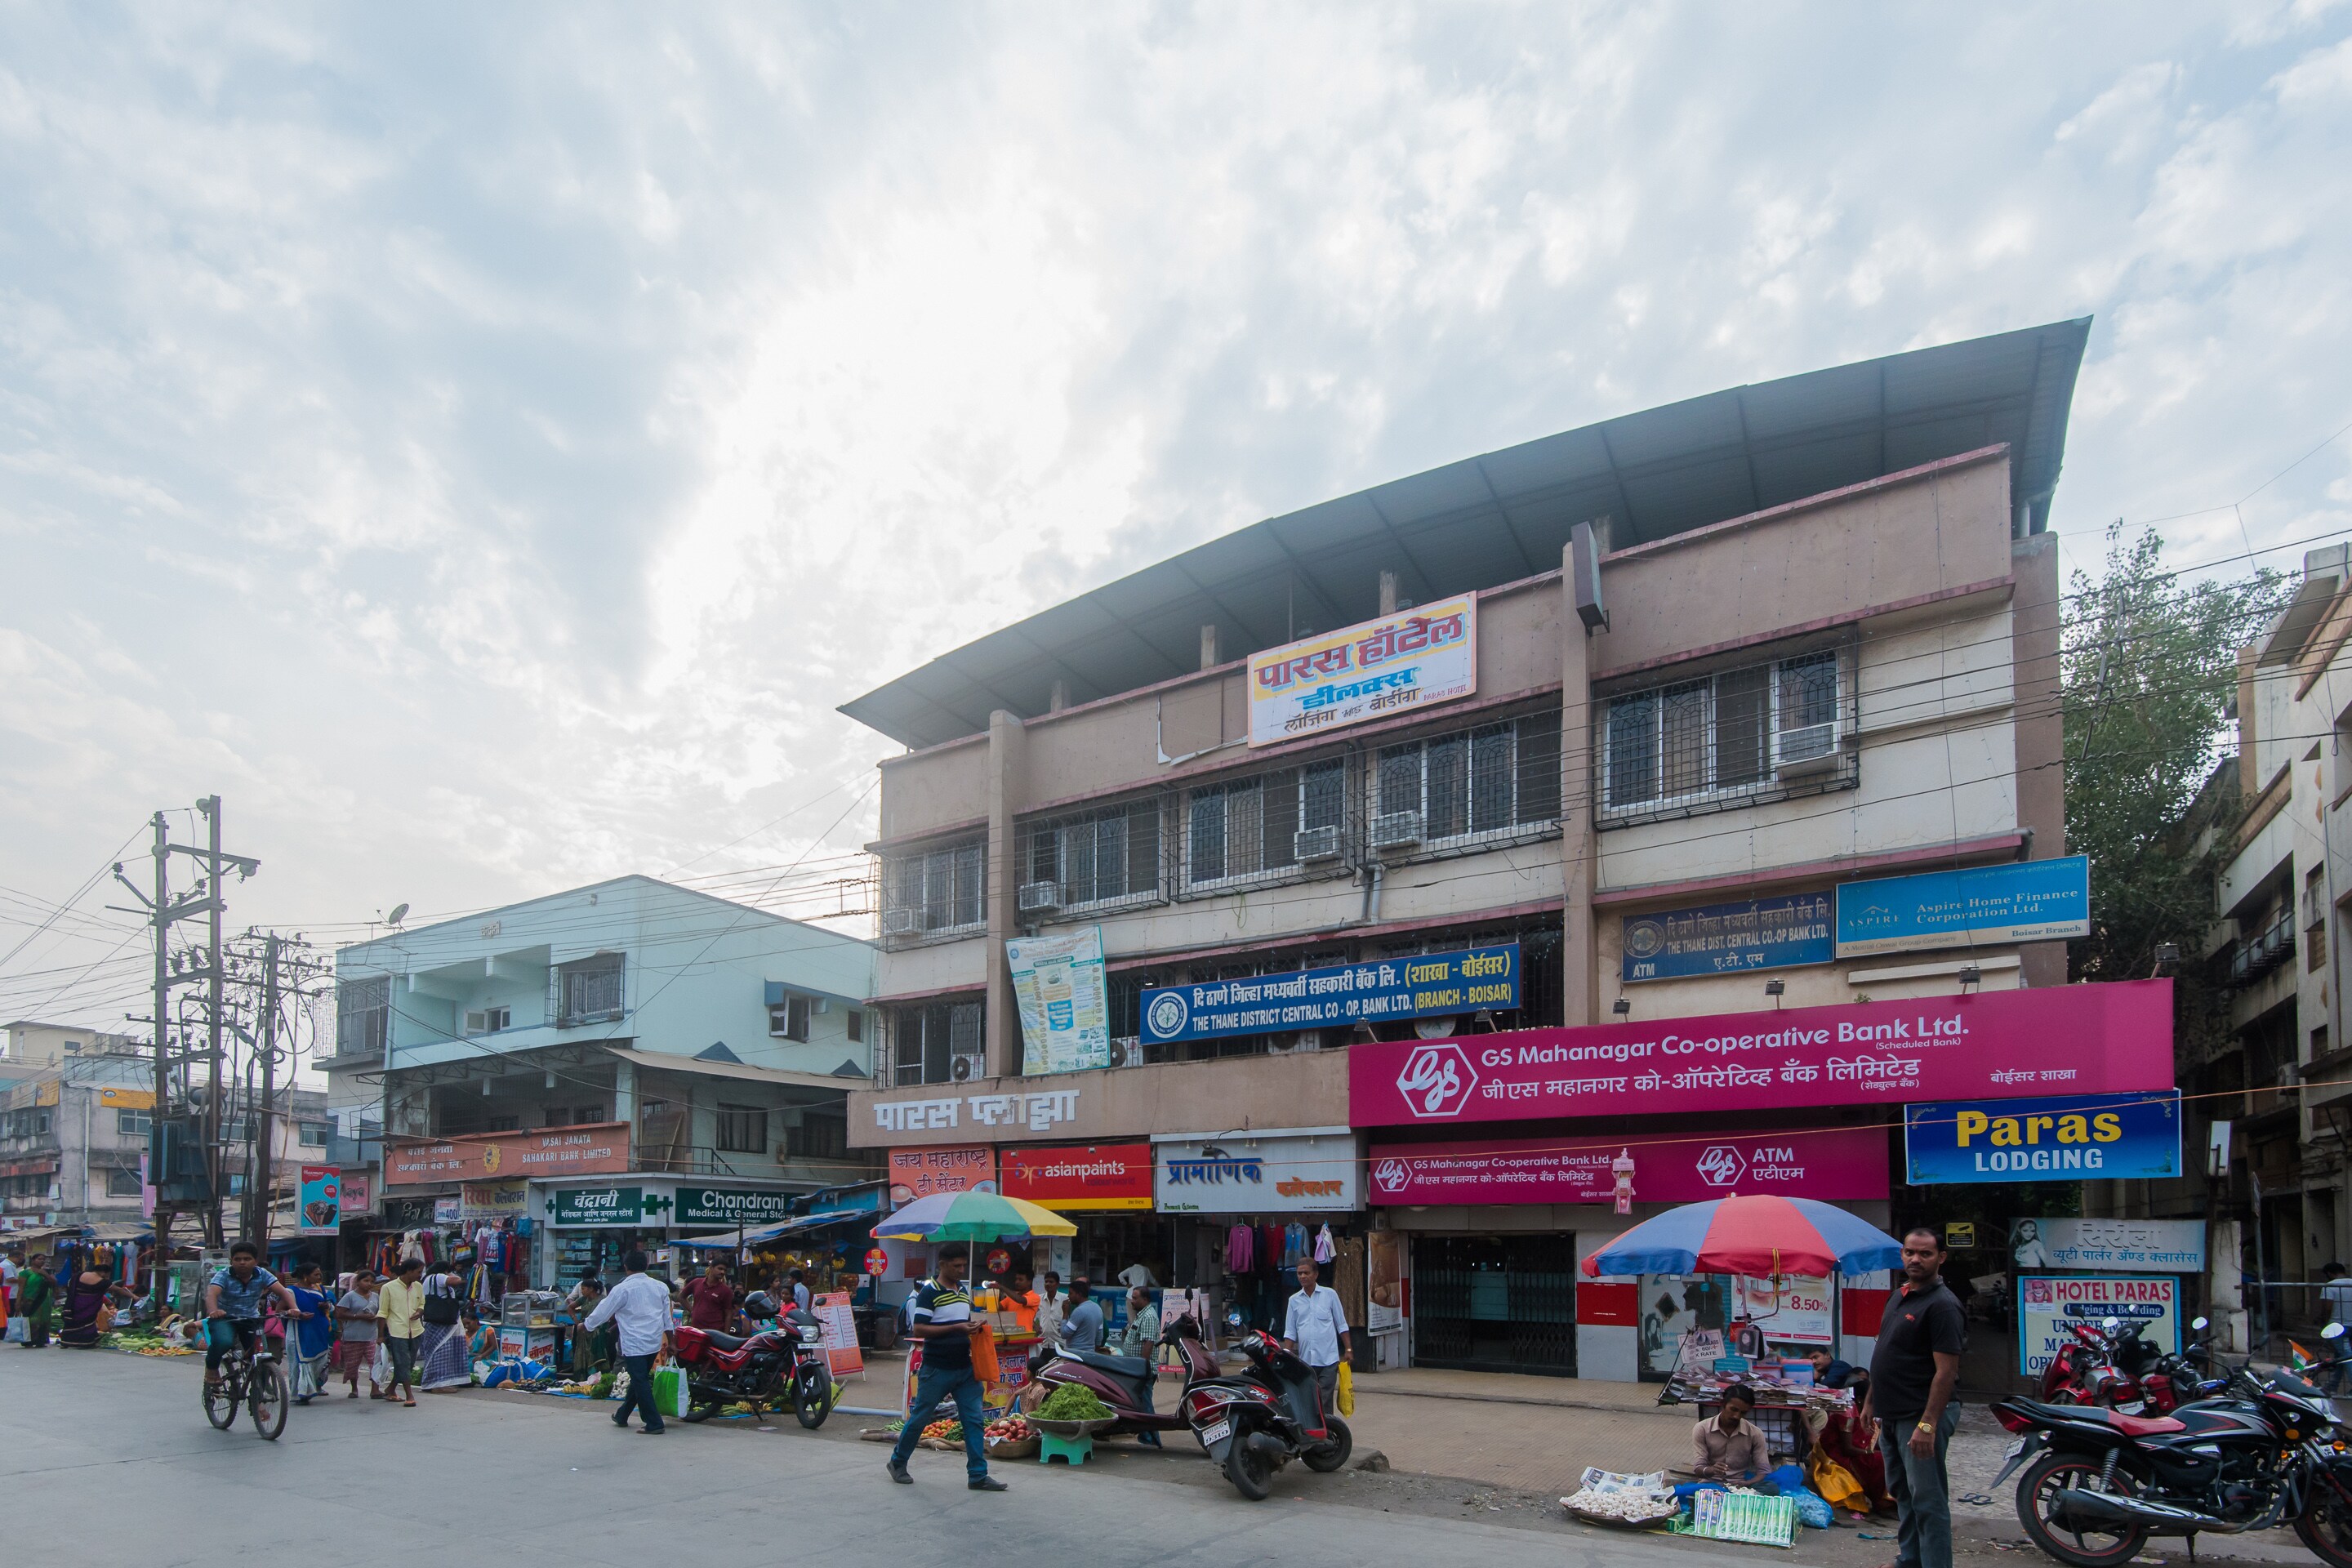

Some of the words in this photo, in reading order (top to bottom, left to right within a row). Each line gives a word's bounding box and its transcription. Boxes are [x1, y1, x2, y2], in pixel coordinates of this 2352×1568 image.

[1254, 644, 1349, 687] पारस
[1356, 612, 1463, 666] हॉटेल
[1295, 666, 1419, 710] डीलक्स
[1447, 684, 1467, 697] HOTEL
[1917, 900, 1964, 915] Aspire
[1969, 894, 2011, 907] Home
[2016, 889, 2078, 902] Finance
[1678, 912, 1695, 934] ठाणे
[1697, 911, 1721, 933] जिल्हा
[1723, 903, 1759, 929] मध्यवर्ती
[1760, 901, 1794, 925] सहकारी
[1797, 897, 1813, 920] बँक
[1847, 914, 1900, 928] ASPIRE
[1917, 906, 2008, 925] Corporation
[2013, 902, 2043, 915] Ltd.
[1667, 941, 1681, 955] THE
[1682, 938, 1706, 953] THANE
[1708, 936, 1726, 951] DIST.
[1727, 932, 1761, 948] CENTRAL
[1788, 925, 1811, 941] BANK
[1811, 924, 1829, 938] LTD.
[2011, 929, 2043, 938] Boisar
[2046, 924, 2081, 933] Branch
[1876, 941, 1897, 949] Oswal
[1899, 939, 1922, 947] Group
[1923, 936, 1956, 944] Company
[1633, 962, 1655, 978] ATM
[1193, 987, 1205, 1008] दि
[1206, 984, 1228, 1006] ठाणे
[1230, 982, 1261, 1004] जिल्हा
[1263, 974, 1308, 1000] मध्यवर्ती
[1308, 969, 1355, 995] सहकारी
[1356, 967, 1376, 990] बँक
[1379, 964, 1401, 987] लि.
[1192, 1015, 1209, 1031] THE
[1211, 1013, 1239, 1030] THANE
[1241, 1008, 1280, 1027] DISTRICT
[1282, 1004, 1323, 1023] CENTRAL
[1325, 1002, 1339, 1018] CO
[1346, 999, 1360, 1017] OP.
[1362, 996, 1389, 1014] BANK
[1391, 994, 1412, 1013] LTD.
[1414, 988, 1460, 1013] (BRANCH
[1468, 982, 1511, 1004] BOISAR)
[1481, 1048, 1512, 1067] GS
[1518, 1040, 1655, 1067] Mahanagar
[1661, 1024, 1829, 1059] Co-operative
[1838, 1017, 1910, 1043] Bank
[1918, 1013, 1969, 1037] Ltd.
[1875, 1040, 1930, 1052] (Scheduled
[1933, 1036, 1962, 1048] Bank)
[1545, 1076, 1628, 1098] महानगर
[1780, 1057, 1820, 1085] बँक
[1827, 1054, 1921, 1080] लिमिटेड
[1990, 1069, 2036, 1084] बोईसर
[2039, 1067, 2077, 1080] शाखा
[873, 1097, 962, 1132] पारस
[968, 1089, 1080, 1131] प्लाझा
[1956, 1110, 2122, 1147] Paras
[430, 1145, 453, 1154] जनता
[541, 1137, 561, 1147] VASAI
[564, 1134, 591, 1145] JANATA
[522, 1152, 557, 1163] SAHAKARI
[560, 1150, 579, 1160] BANK
[583, 1147, 611, 1160] LIMITED
[893, 1151, 922, 1169] जय
[927, 1148, 989, 1171] महाराष्ट्र
[1414, 1160, 1428, 1169] GS
[1430, 1157, 1489, 1170] Mahanagar
[1491, 1156, 1559, 1169] Co-operative
[1561, 1155, 1590, 1165] Bank
[1592, 1154, 1612, 1165] Ltd.
[1753, 1147, 1794, 1163] ATM
[1975, 1148, 2103, 1172] LODGING
[1045, 1160, 1125, 1183] asianpaints
[1166, 1157, 1264, 1184] प्रामाणिक
[1442, 1174, 1477, 1184] महानगर
[1539, 1170, 1556, 1182] बँक
[1558, 1169, 1594, 1182] लिमिटेड
[1752, 1167, 1805, 1180] एटीएम
[916, 1174, 932, 1193] टी
[935, 1173, 966, 1194] सेंटर
[1276, 1176, 1343, 1197] कलेक्शन
[574, 1189, 620, 1209] चंद्रानी
[702, 1191, 785, 1209] Chandrani
[561, 1209, 582, 1218] मेडिकल
[583, 1209, 599, 1218] आणि
[688, 1209, 723, 1217] Medical
[725, 1209, 732, 1218] &
[2082, 1246, 2113, 1260] पार्लर
[2149, 1250, 2198, 1263] क्लासेस
[2056, 1281, 2109, 1301] HOTEL
[2114, 1281, 2172, 1301] PARAS
[2066, 1304, 2105, 1316] Lging
[2106, 1305, 2115, 1314] &
[2118, 1304, 2161, 1316] Boding
